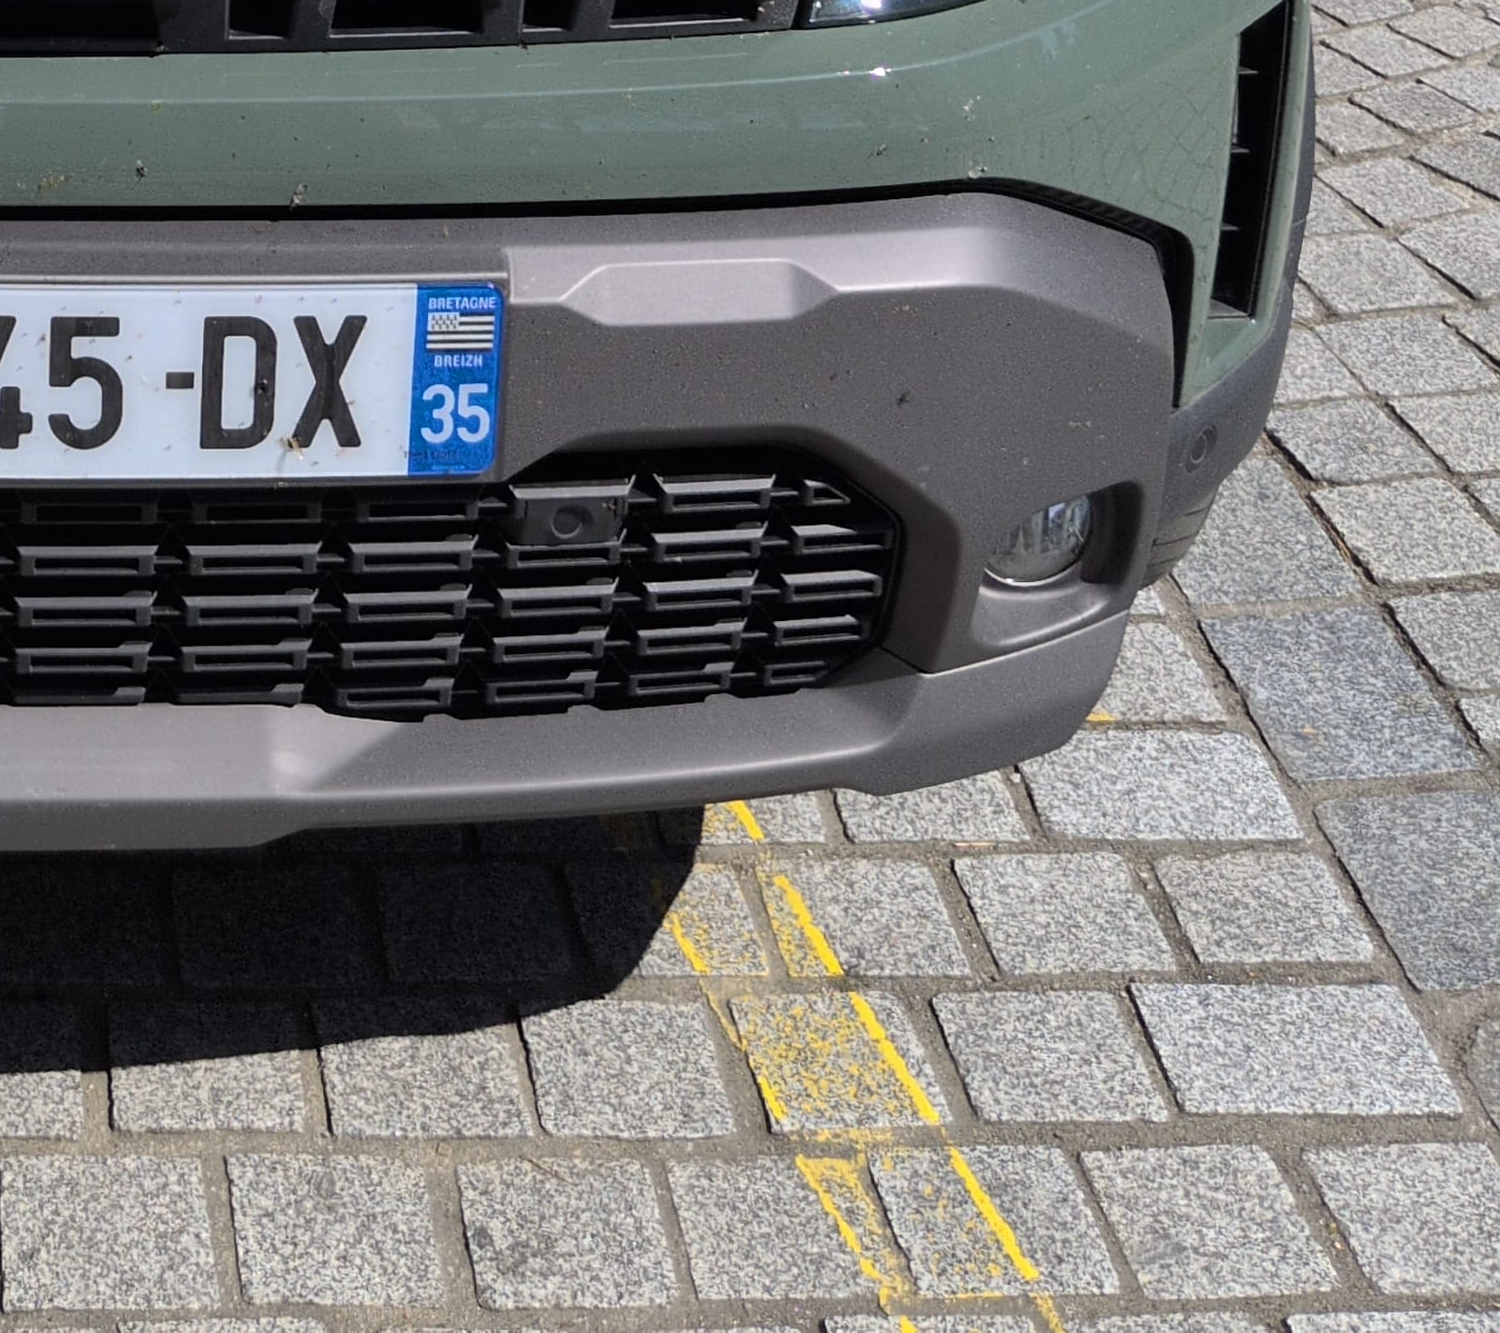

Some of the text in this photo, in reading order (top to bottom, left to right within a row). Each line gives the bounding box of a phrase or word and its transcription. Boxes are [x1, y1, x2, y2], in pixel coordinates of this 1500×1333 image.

[427, 297, 497, 310] BRETAGNE
[433, 354, 484, 368] BREIZH
[420, 383, 491, 444] 35
